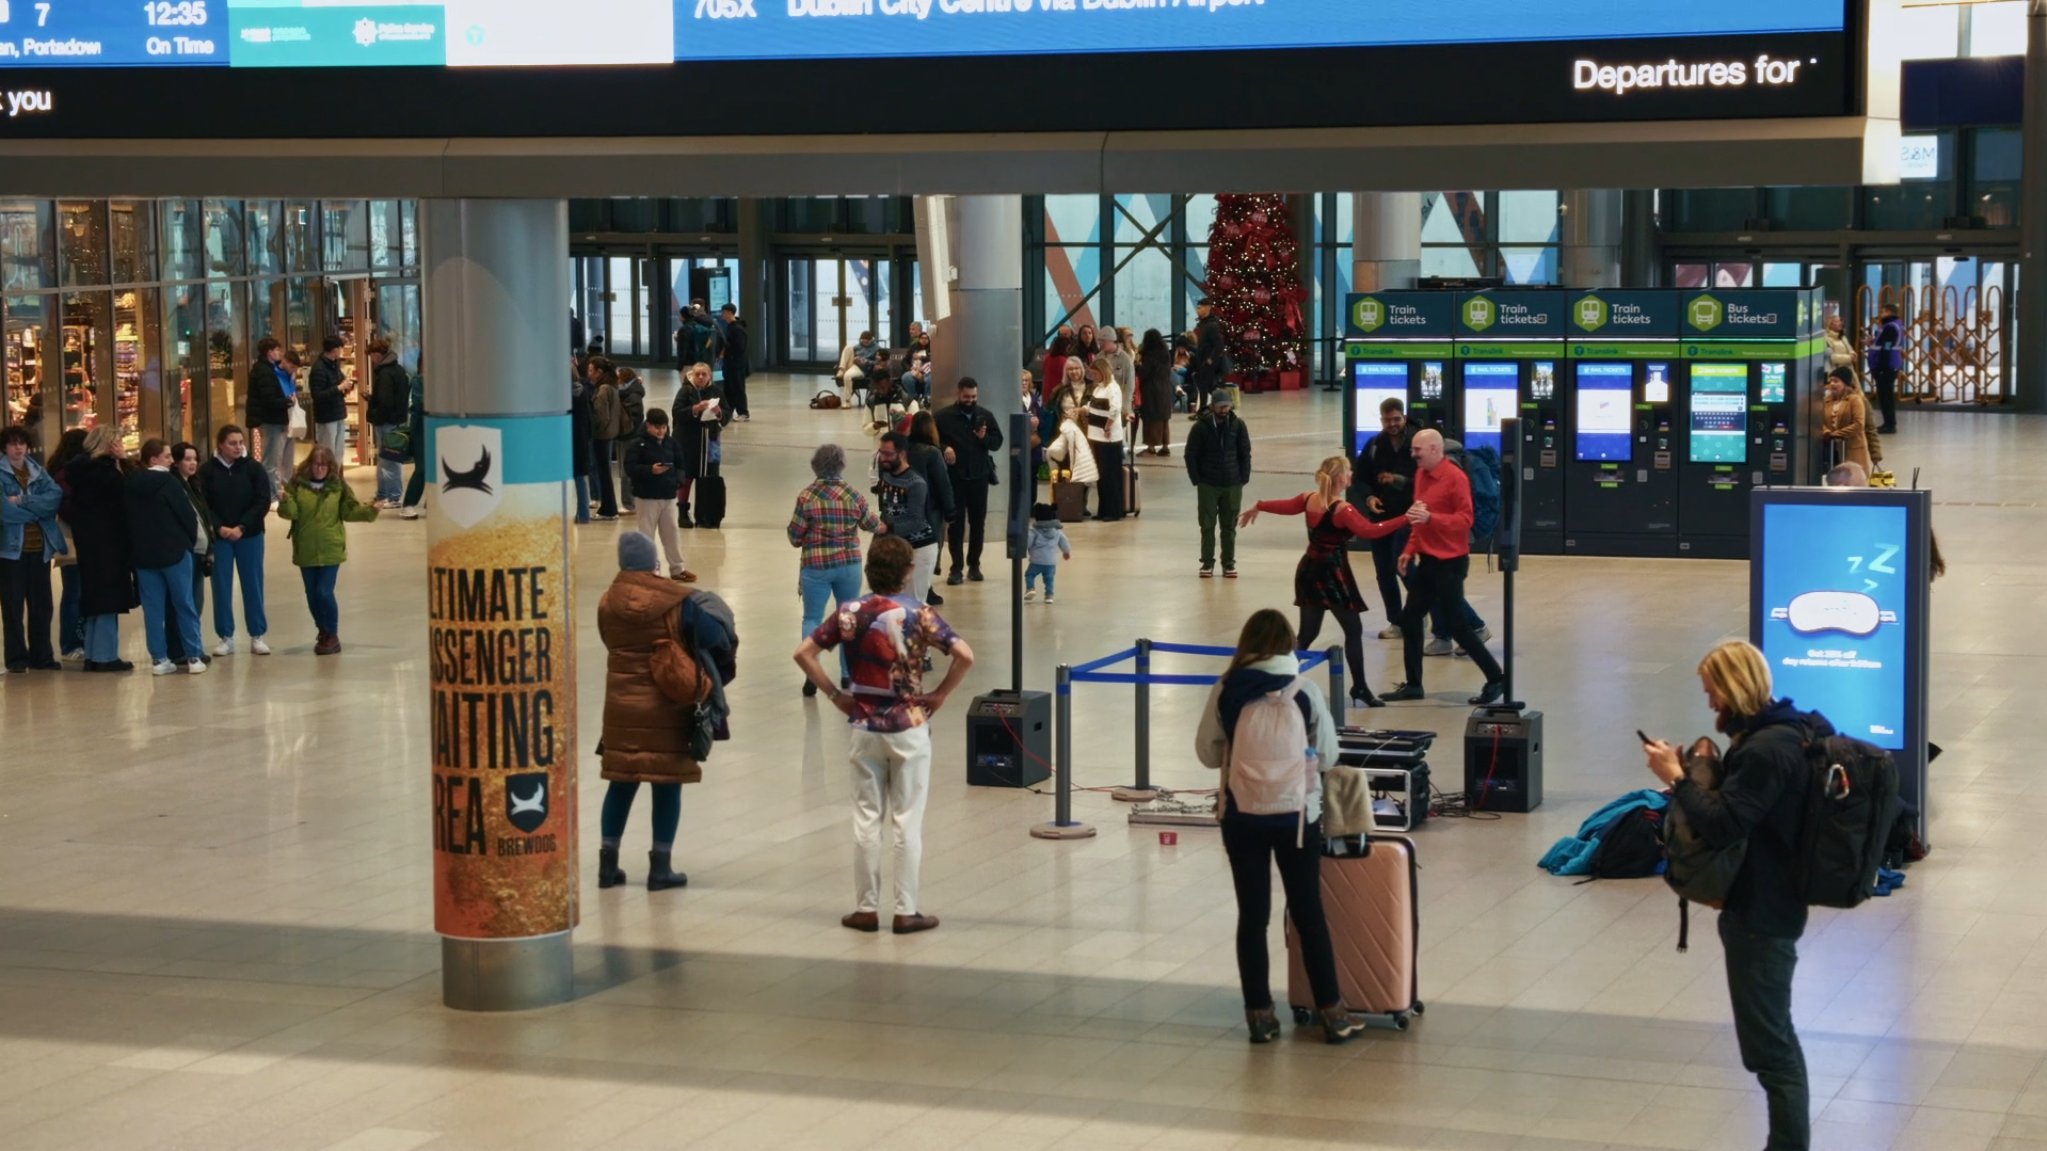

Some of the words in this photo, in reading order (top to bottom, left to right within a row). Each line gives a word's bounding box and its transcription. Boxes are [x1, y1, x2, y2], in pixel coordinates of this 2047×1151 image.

[34, 2, 50, 27] 7
[143, 1, 208, 26] 12:35
[693, 0, 758, 18] 705X
[787, 0, 873, 17] Dublin
[878, 0, 934, 20] City
[145, 37, 172, 55] On
[172, 36, 215, 55] Time
[1574, 58, 1746, 95] Departures
[1755, 54, 1800, 84] for
[8, 90, 53, 117] you
[1389, 305, 1416, 315] Train
[1500, 304, 1528, 314] Train
[1612, 303, 1641, 314] Train
[1727, 303, 1748, 314] Bus
[1389, 314, 1427, 325] tickets
[1501, 314, 1538, 324] tickets
[1612, 313, 1651, 324] tickets
[1728, 313, 1768, 324] tickets
[430, 626, 552, 686] SSENGER
[431, 689, 555, 770] AITING
[497, 834, 557, 857] BREWDOG
